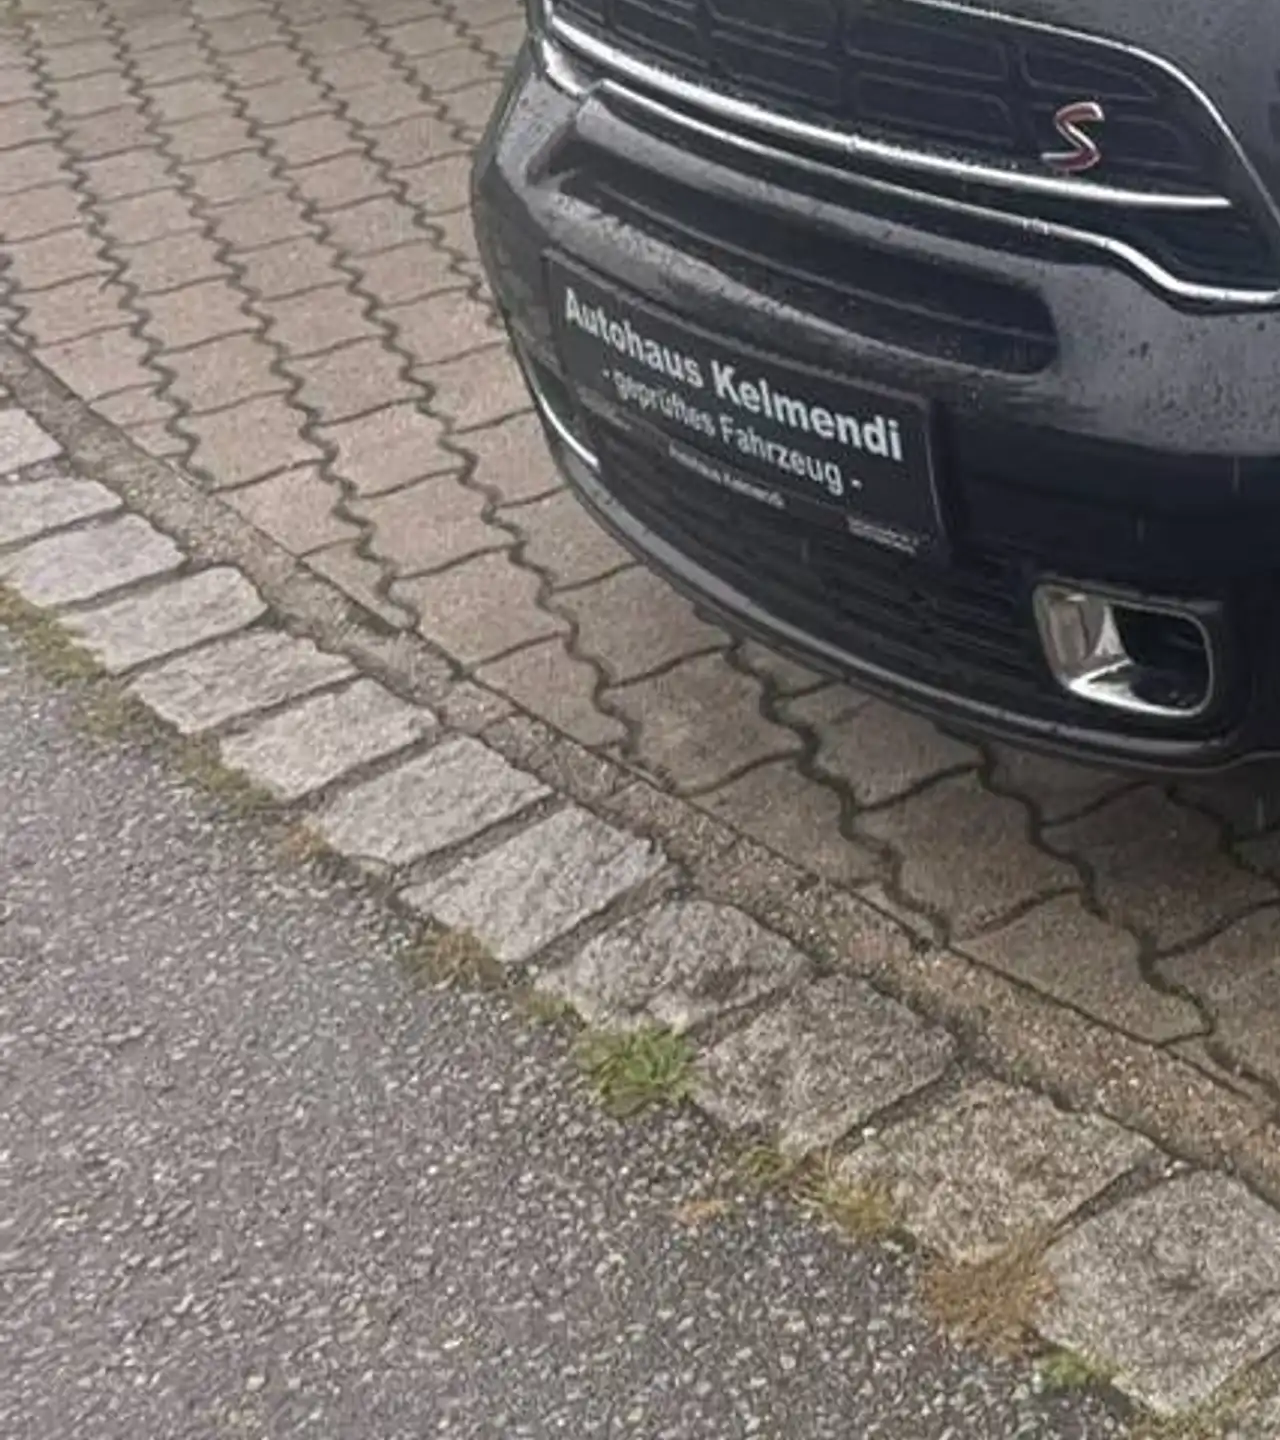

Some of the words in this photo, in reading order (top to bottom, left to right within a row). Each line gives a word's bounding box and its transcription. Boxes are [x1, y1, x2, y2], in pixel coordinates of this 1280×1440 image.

[1040, 101, 1105, 173] S
[566, 287, 704, 389] Autohaus
[711, 360, 904, 462] Kelmendi
[720, 413, 845, 497] Fahrzeug
